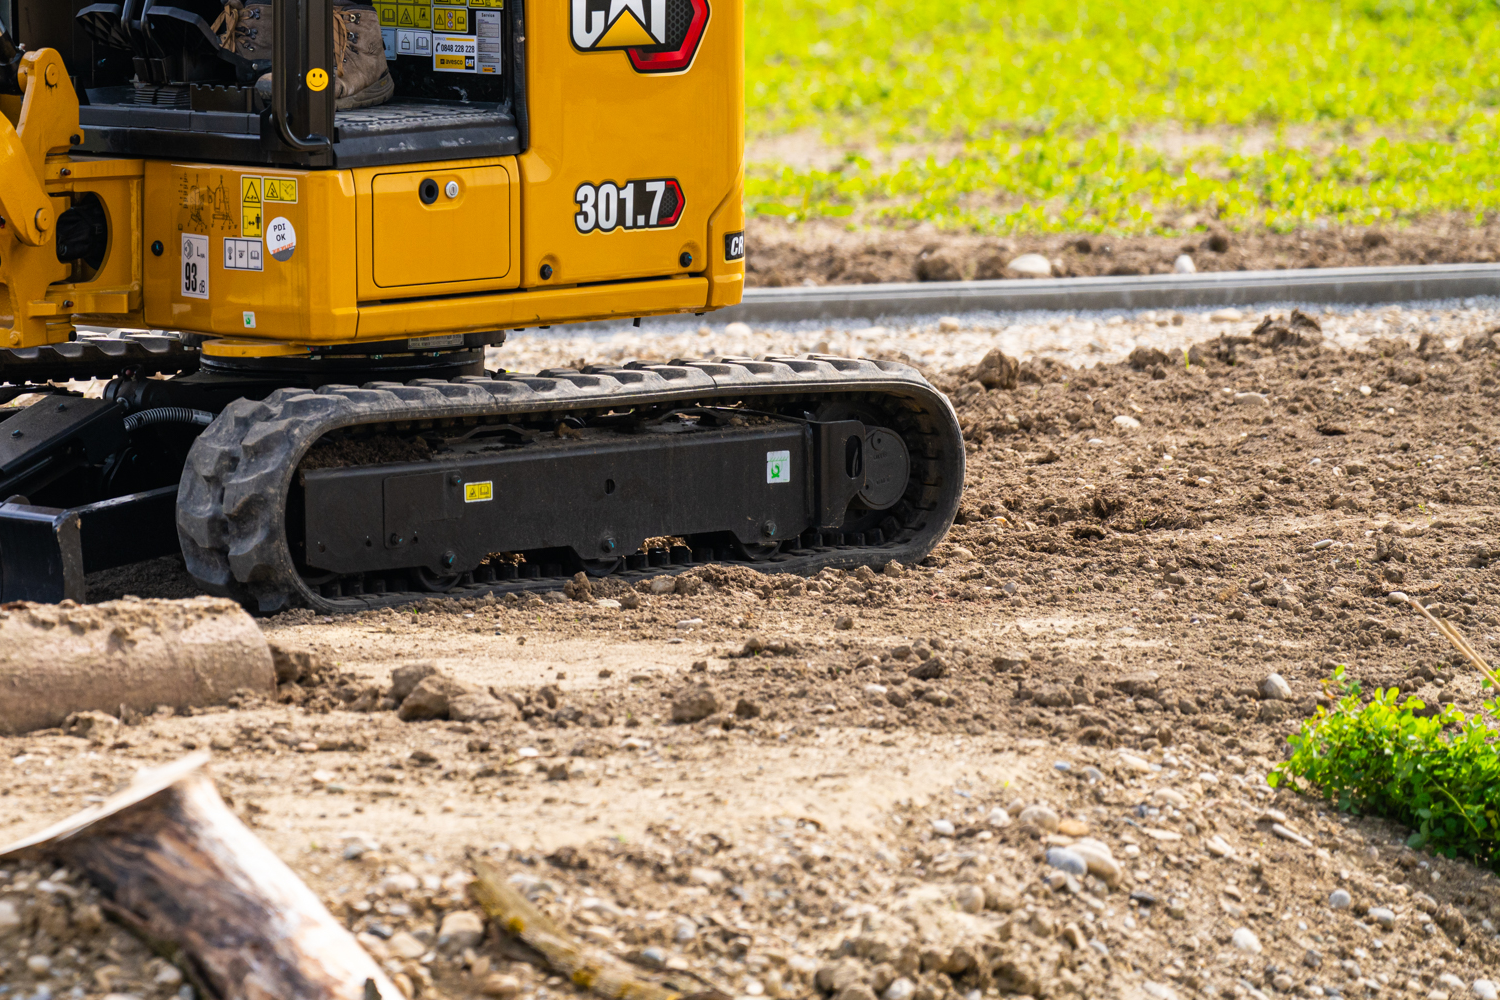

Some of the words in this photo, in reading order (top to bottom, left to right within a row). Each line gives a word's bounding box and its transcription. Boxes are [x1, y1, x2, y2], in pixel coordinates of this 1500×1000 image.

[441, 44, 453, 52] 0848
[454, 44, 465, 53] 228
[465, 45, 475, 53] 228
[575, 180, 666, 231] 301.7
[273, 223, 286, 232] PDI
[275, 233, 286, 242] OK
[185, 262, 197, 292] 93
[199, 280, 206, 293] dB
